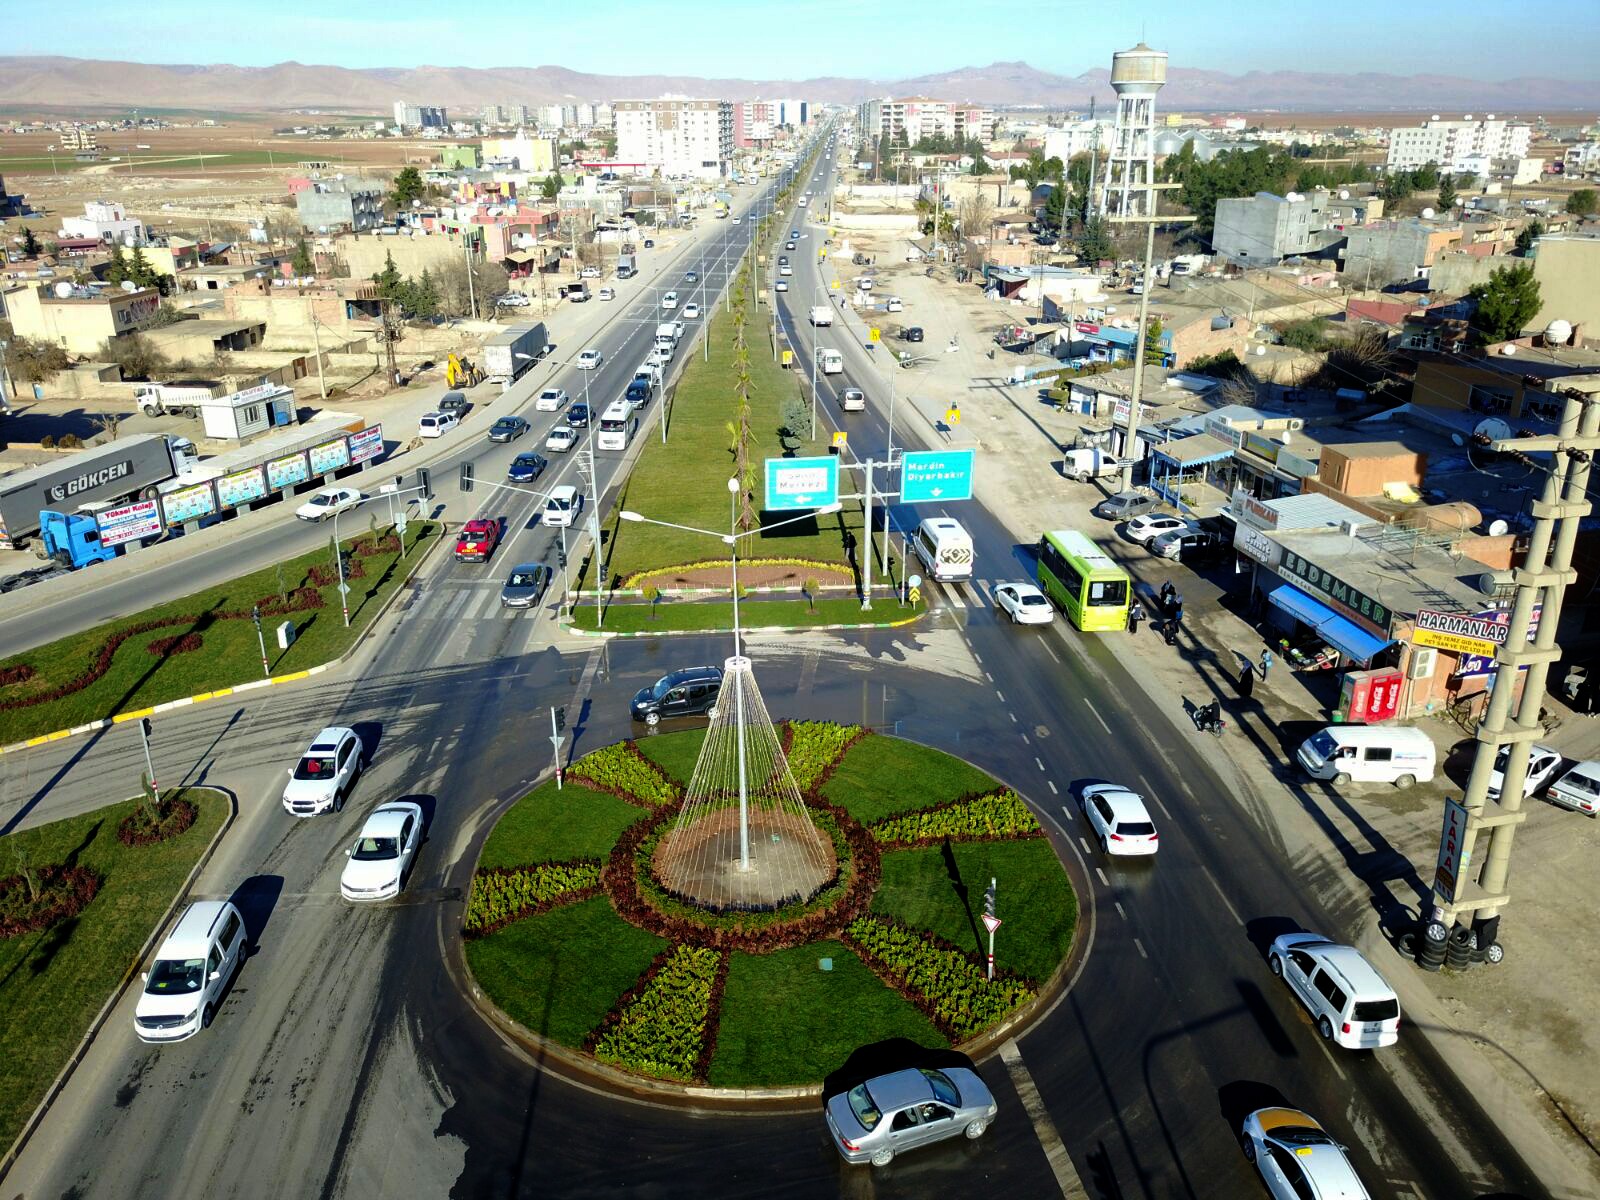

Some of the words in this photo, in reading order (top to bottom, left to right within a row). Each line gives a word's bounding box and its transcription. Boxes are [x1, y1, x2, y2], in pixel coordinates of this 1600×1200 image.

[67, 461, 127, 496] GÖKÇEN
[908, 462, 945, 471] Mardin
[132, 501, 154, 512] Koleji
[1285, 552, 1385, 624] ERDEMLER
[1418, 611, 1508, 641] HARMANLAR
[1444, 809, 1458, 871] LARA
